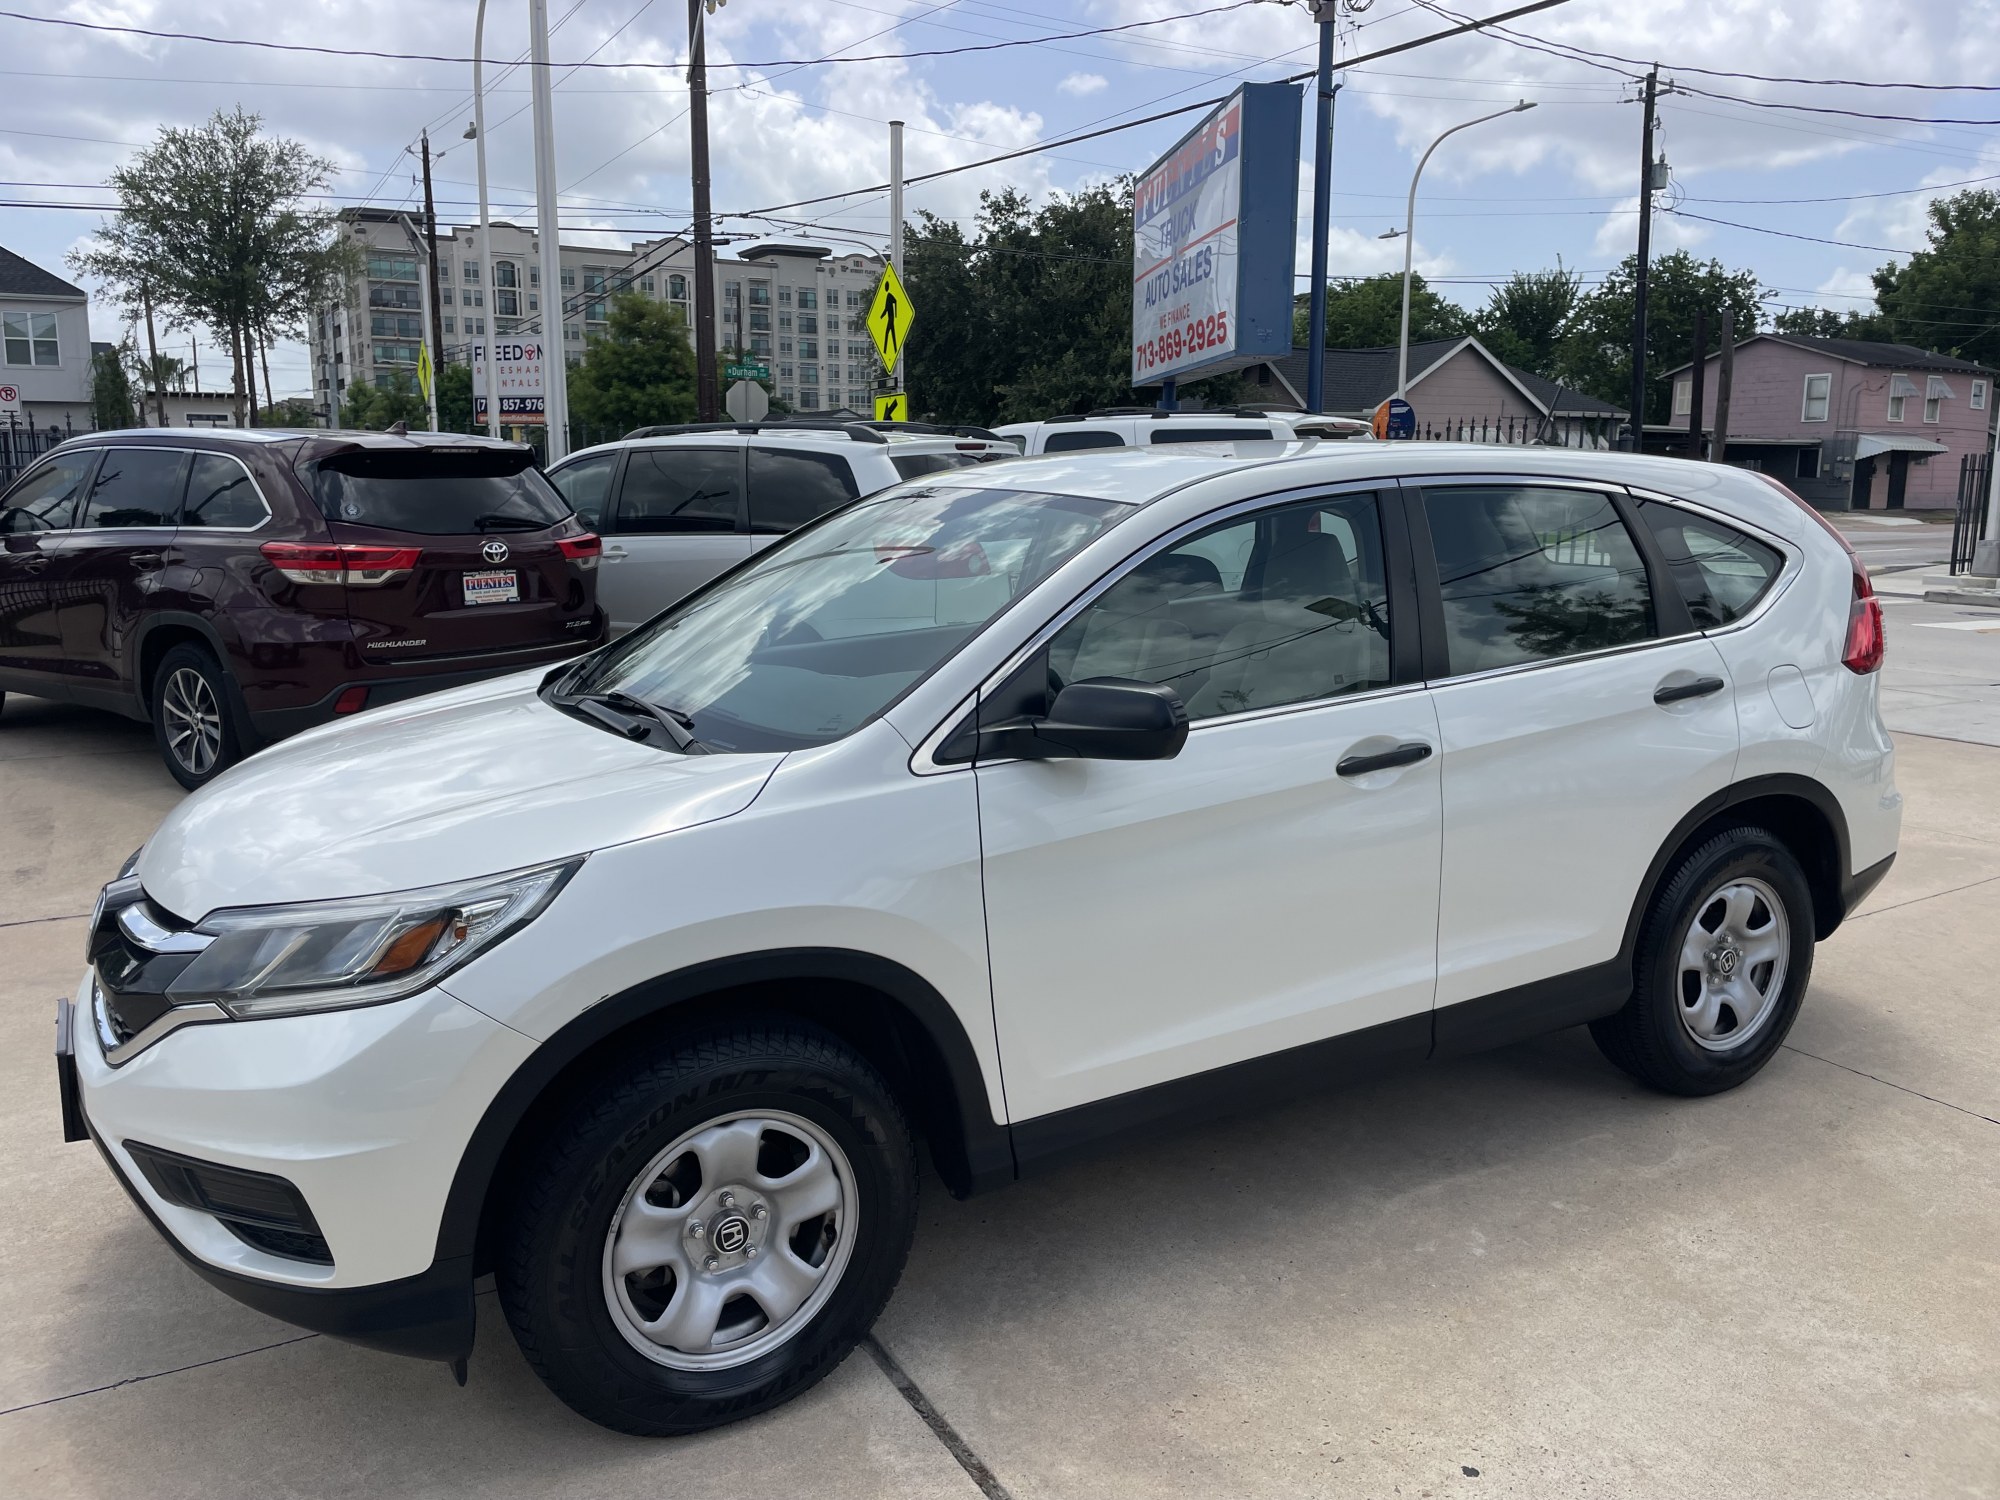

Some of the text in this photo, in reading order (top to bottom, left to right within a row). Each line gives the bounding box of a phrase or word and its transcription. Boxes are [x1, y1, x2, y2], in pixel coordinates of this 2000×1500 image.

[1160, 200, 1197, 251] TRUCK
[1145, 269, 1170, 309] AUTO
[1172, 245, 1212, 294] SALES
[1159, 303, 1190, 330] WE FINANCE
[1137, 311, 1227, 371] 713-869-2925
[476, 365, 540, 375] RESHAR
[732, 367, 758, 377] Durham
[502, 379, 540, 387] NTALS
[502, 399, 544, 411] 857-976
[468, 577, 512, 590] FUENTES
[366, 639, 427, 649] HIGHLANDER
[569, 1086, 699, 1233] SEASON
